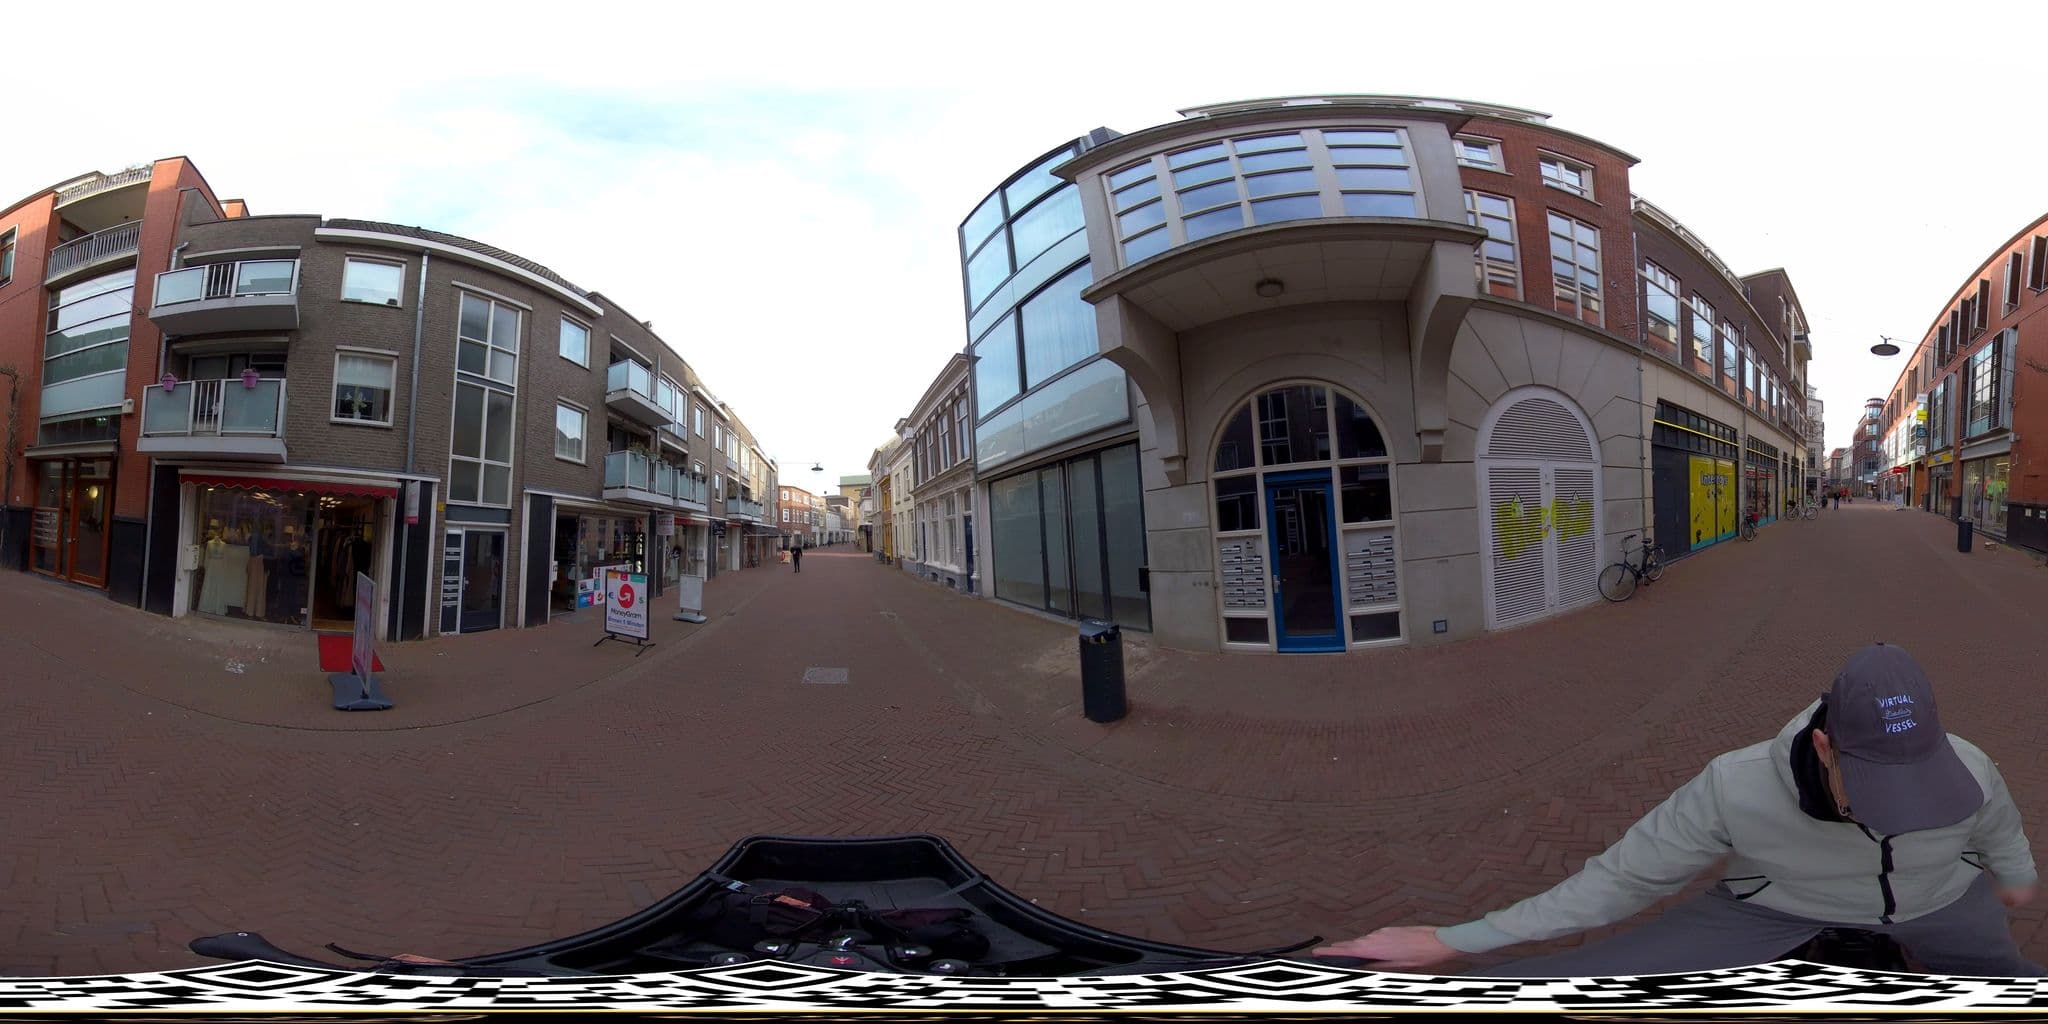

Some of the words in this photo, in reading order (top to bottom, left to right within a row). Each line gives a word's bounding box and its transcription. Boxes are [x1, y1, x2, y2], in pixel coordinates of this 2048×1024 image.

[611, 608, 642, 619] MoneyGram
[1876, 695, 1914, 707] VIRTUAL
[1886, 720, 1917, 733] VESSEL
